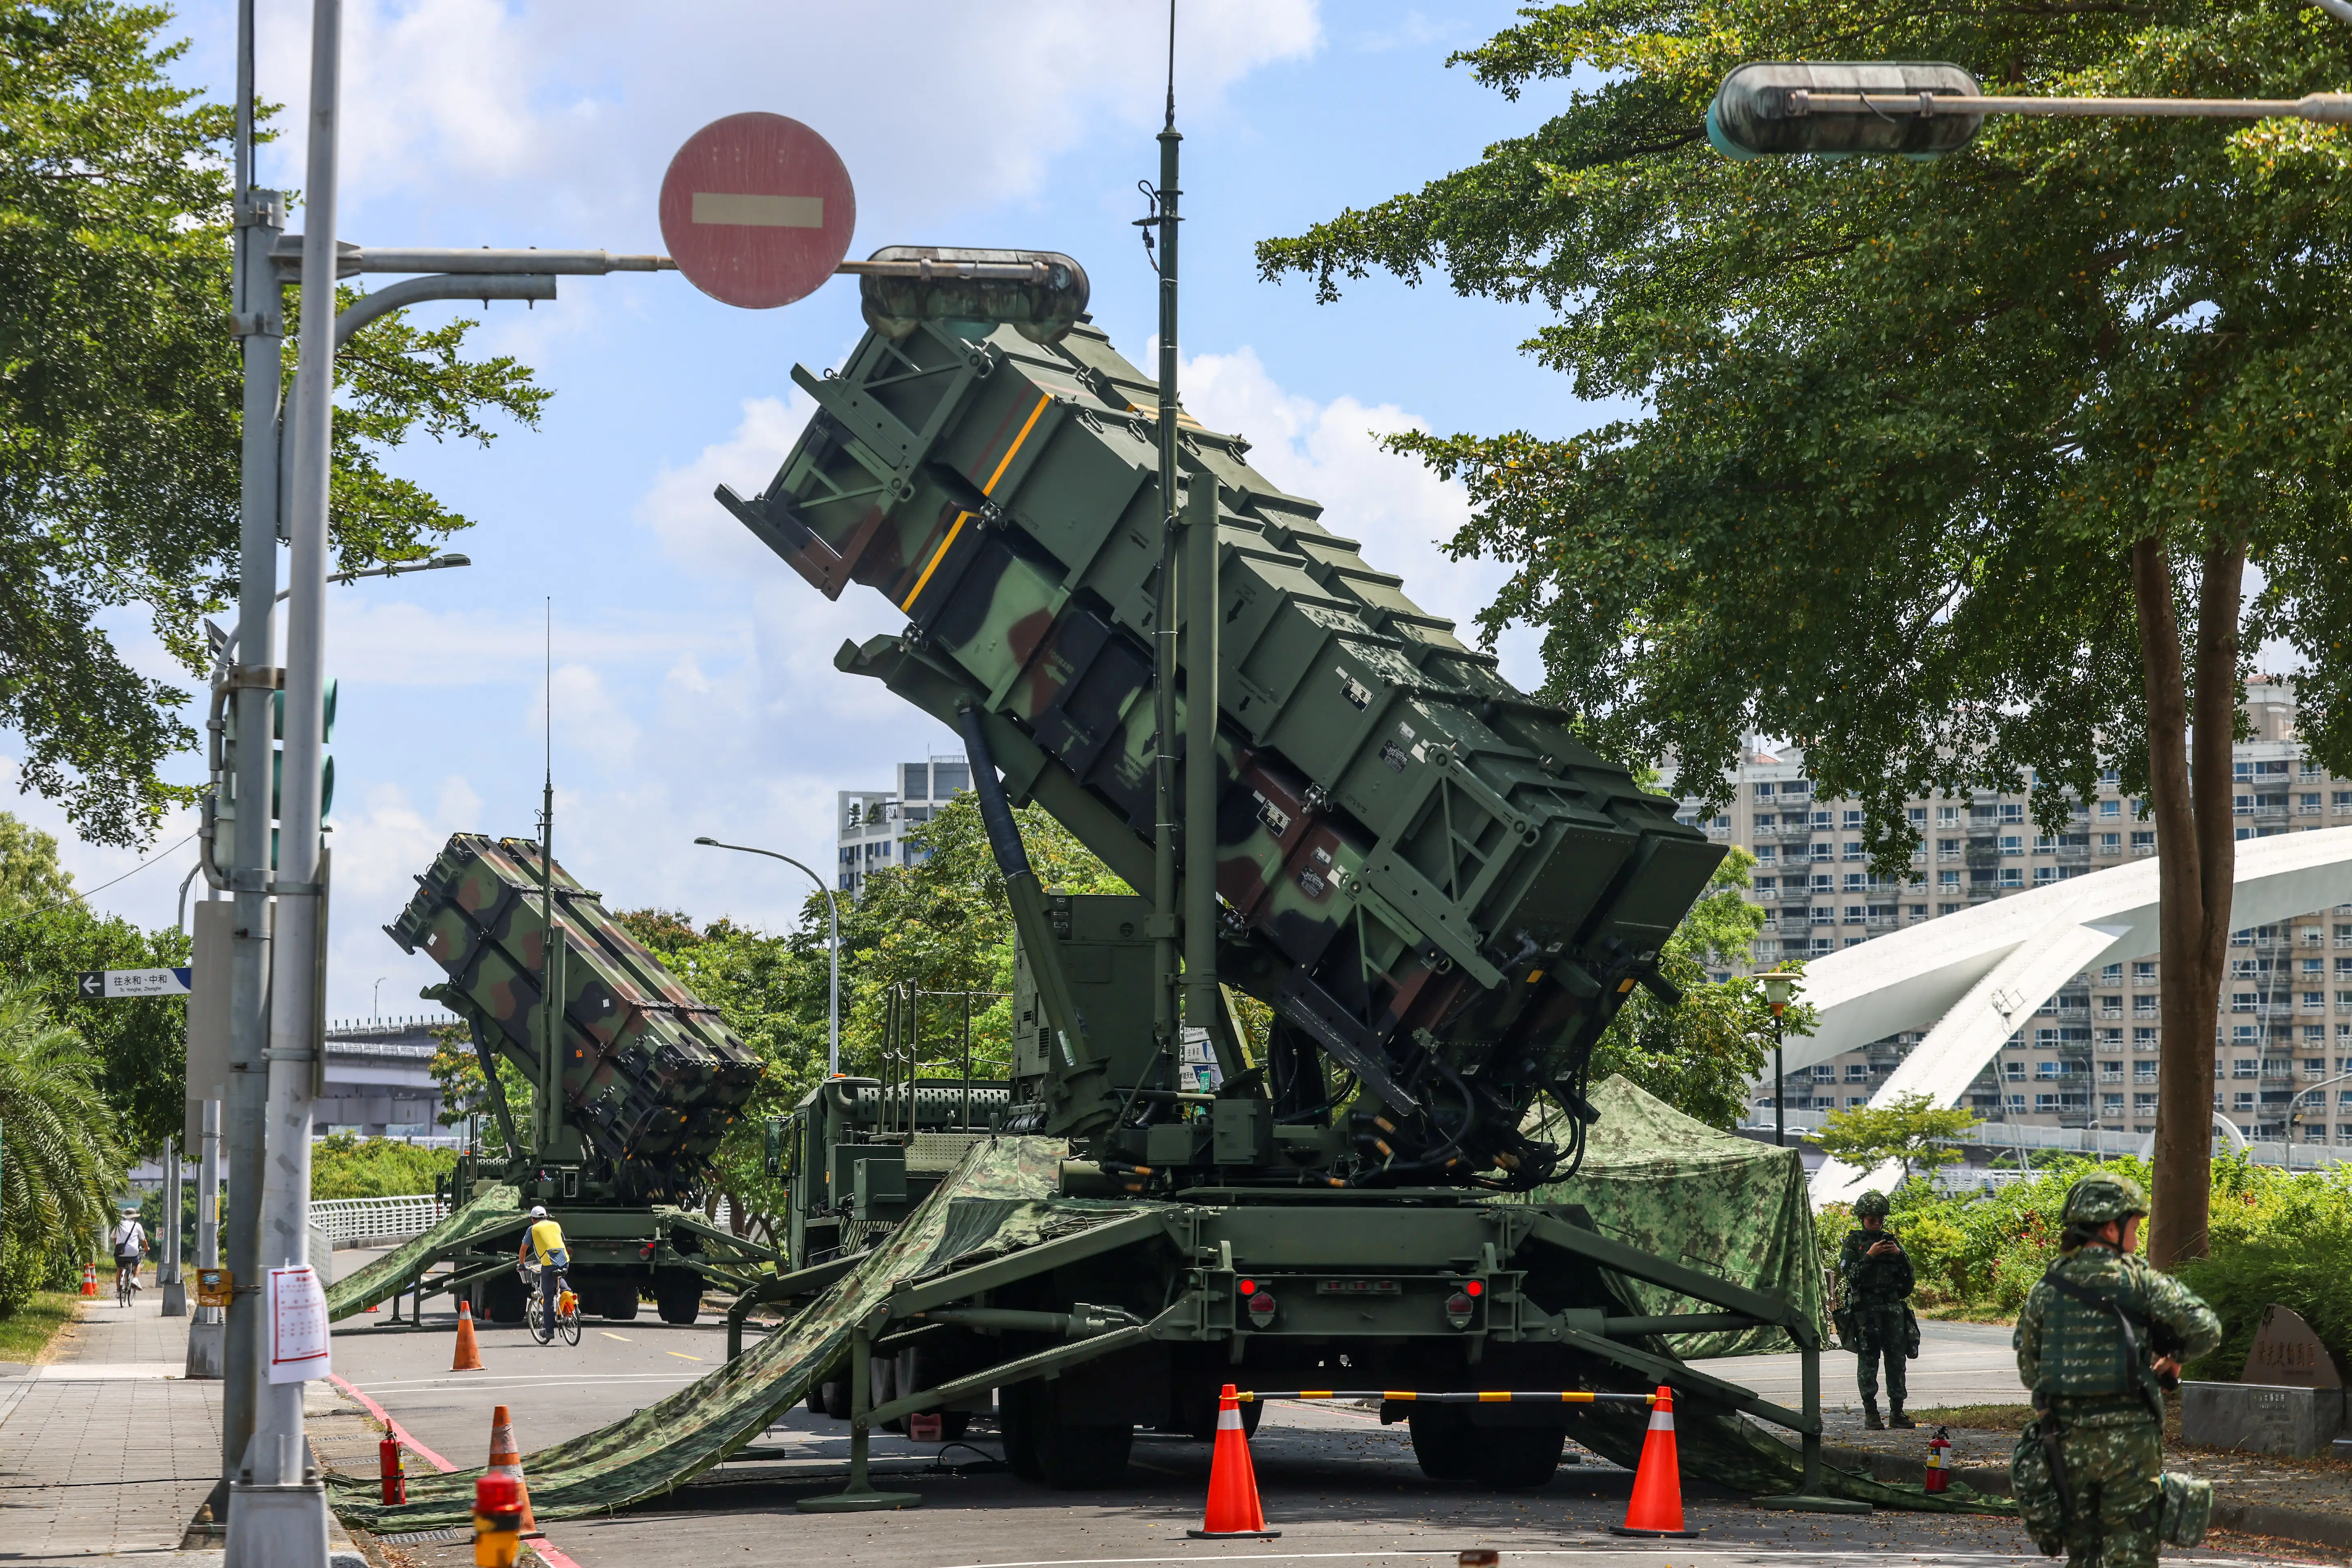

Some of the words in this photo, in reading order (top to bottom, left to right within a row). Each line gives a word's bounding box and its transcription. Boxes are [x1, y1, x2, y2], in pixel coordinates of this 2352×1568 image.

[114, 974, 166, 986] 往永和、中和
